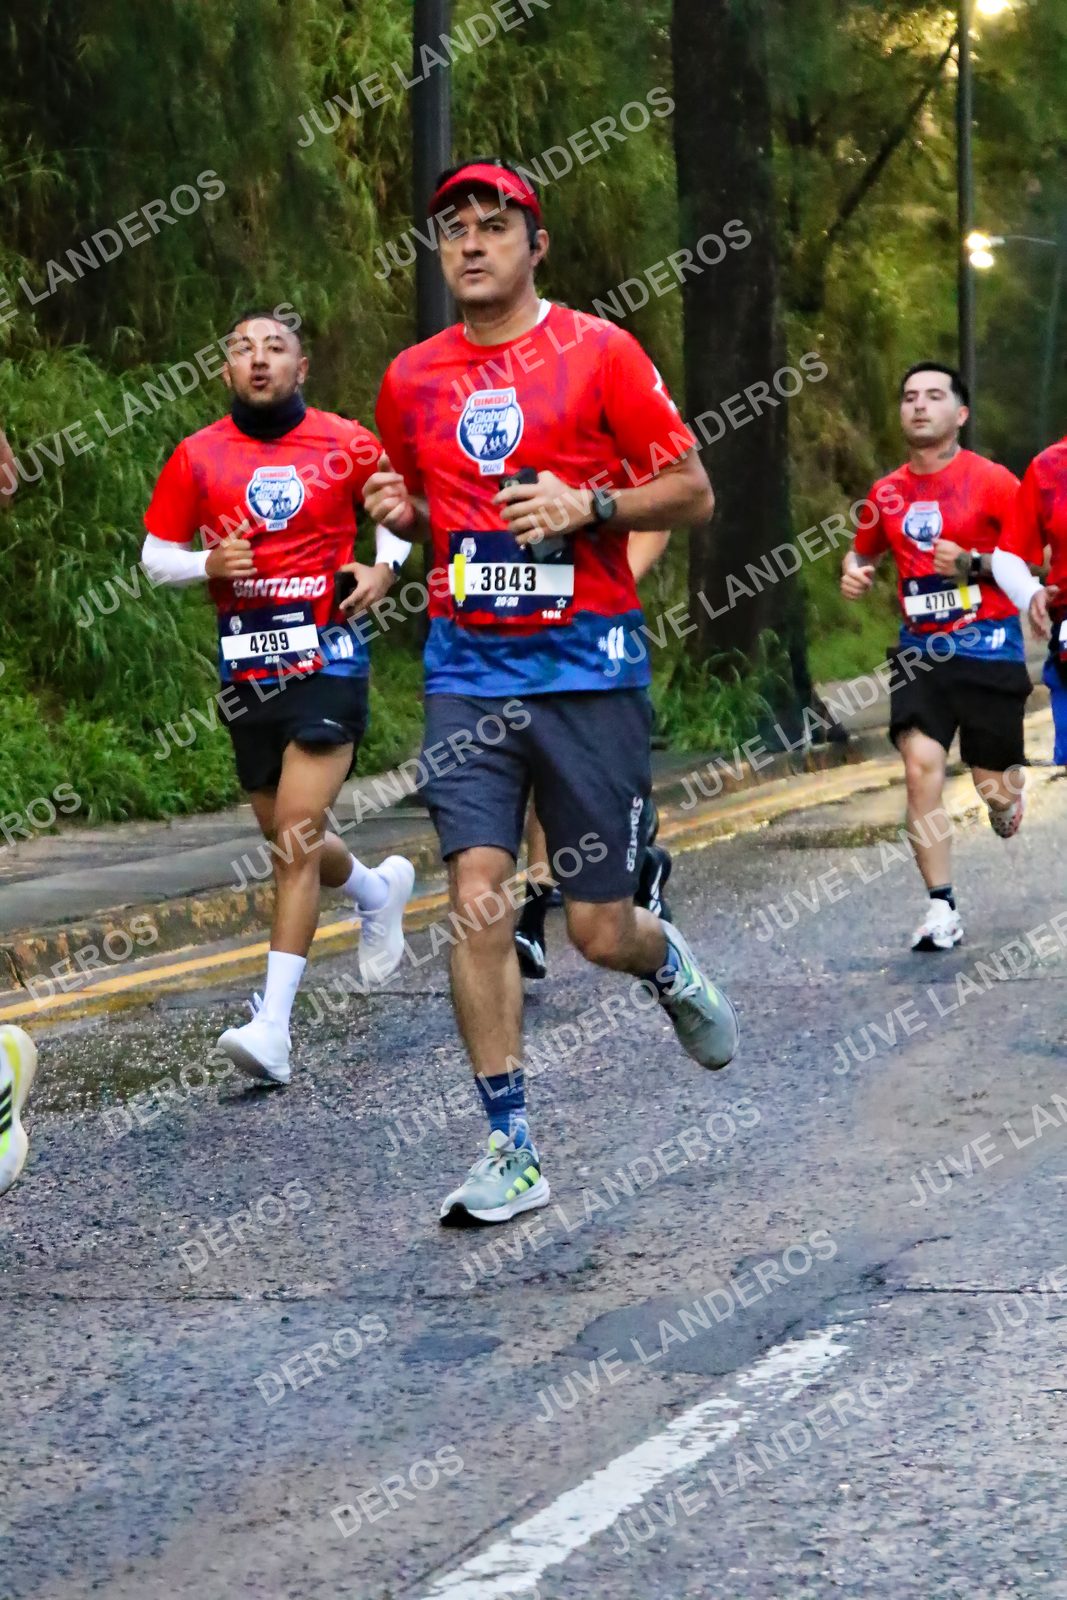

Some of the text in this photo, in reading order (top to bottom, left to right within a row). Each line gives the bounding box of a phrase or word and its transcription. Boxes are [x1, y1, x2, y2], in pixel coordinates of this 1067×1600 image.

[473, 395, 510, 407] BIMBO
[472, 409, 508, 424] Global
[466, 422, 495, 436] Race
[233, 576, 327, 598] SANTIAGO
[481, 566, 536, 592] 3843
[925, 591, 956, 611] 4770
[541, 610, 562, 619] 10K
[250, 632, 290, 654] 4299
